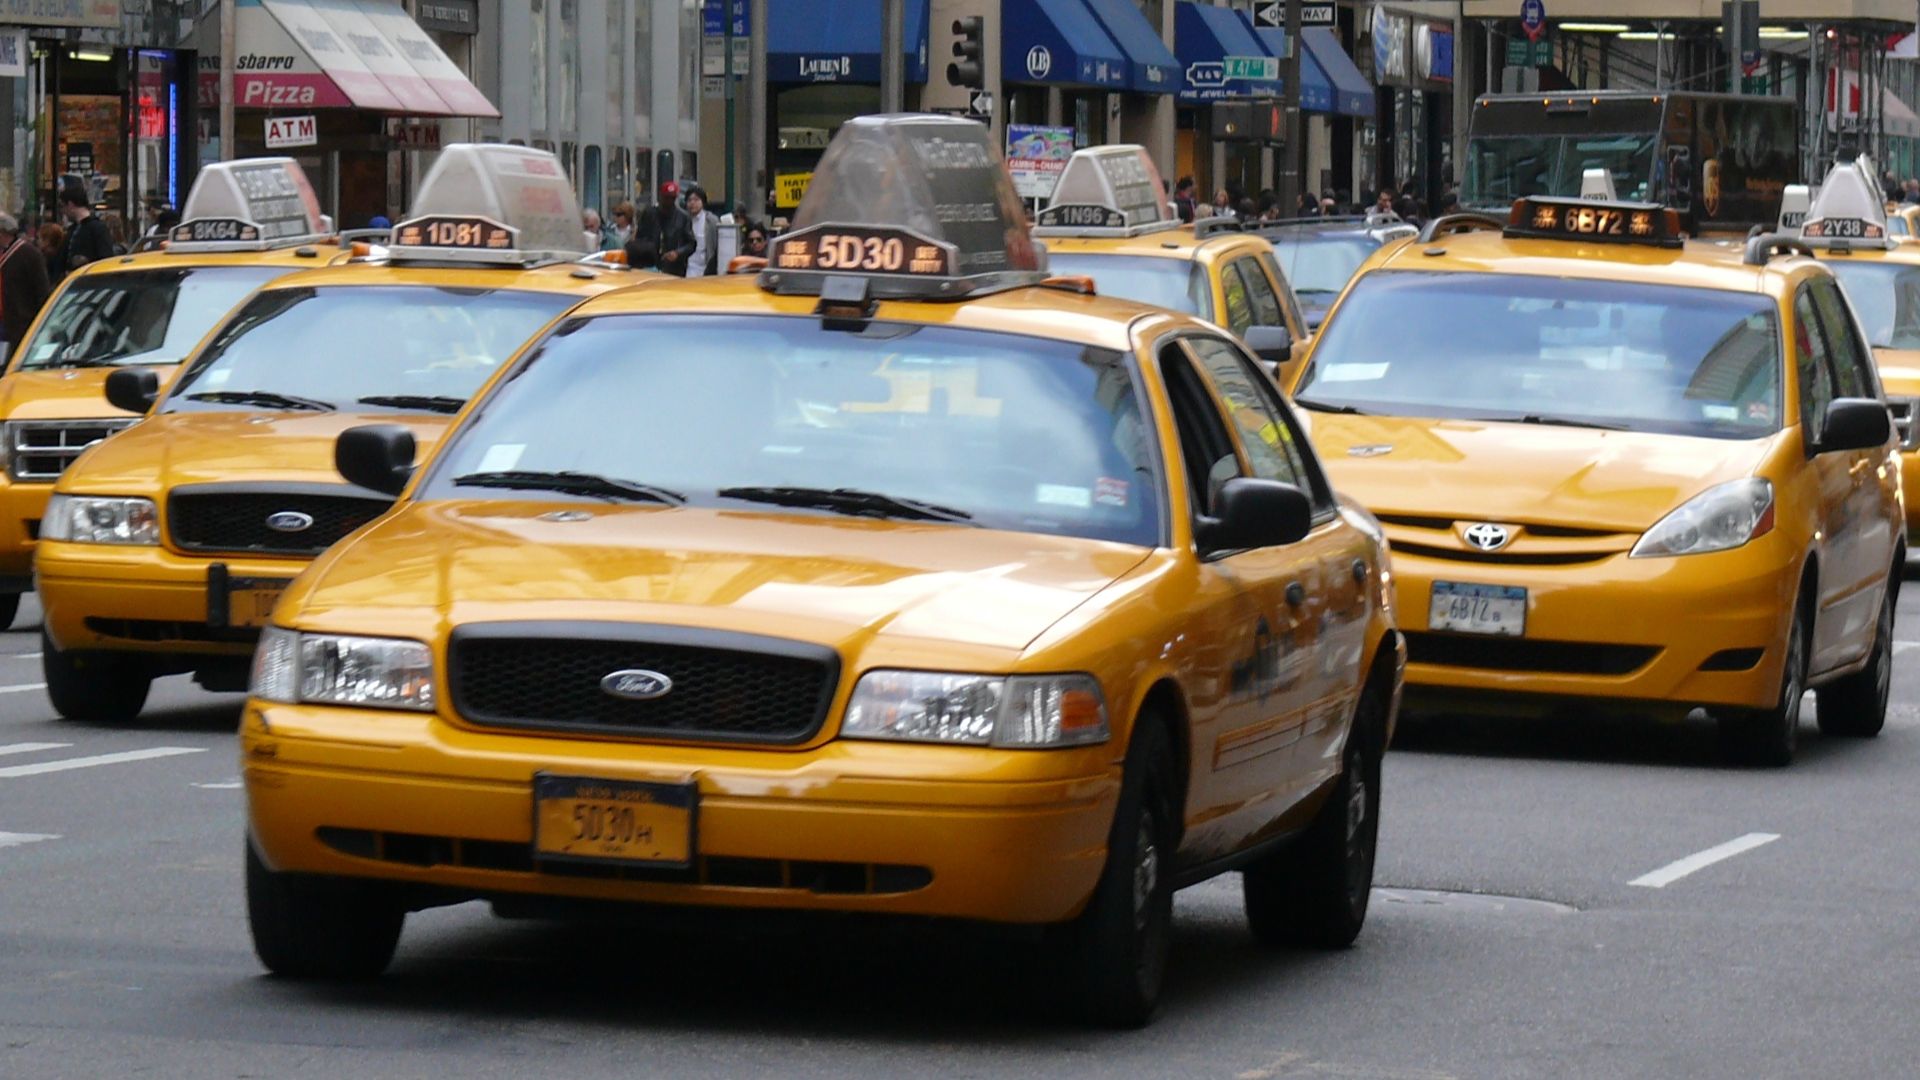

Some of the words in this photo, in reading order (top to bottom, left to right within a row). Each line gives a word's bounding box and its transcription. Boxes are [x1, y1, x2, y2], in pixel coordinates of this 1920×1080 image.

[1269, 9, 1284, 19] ON
[1303, 9, 1326, 18] WAY
[236, 53, 295, 70] sbarro
[841, 56, 850, 75] B
[1032, 51, 1046, 70] LB
[1237, 60, 1251, 76] 47
[244, 81, 316, 104] Pizza
[268, 120, 313, 139] ATM
[397, 125, 440, 143] ATM
[1061, 207, 1103, 224] 1N96
[1564, 207, 1623, 235] 6B72
[194, 221, 238, 240] 8K64
[426, 221, 482, 246] 1D81
[1824, 220, 1860, 236] 2Y38
[817, 235, 904, 271] 5D30
[616, 675, 656, 692] Ford
